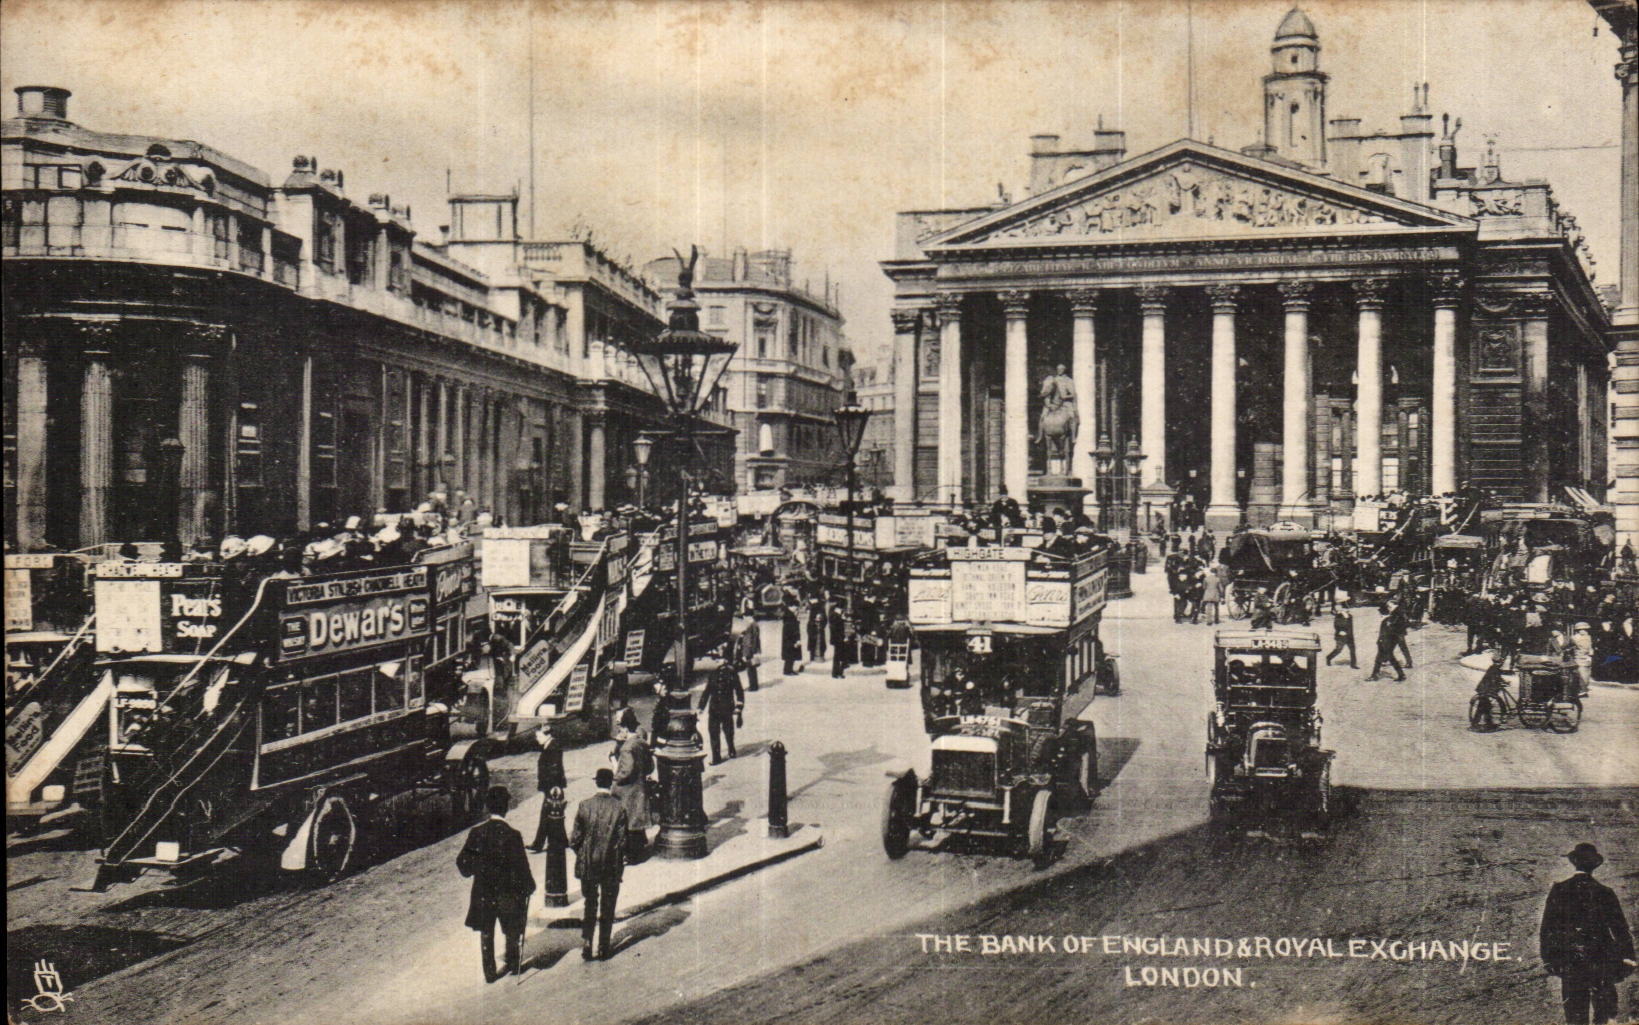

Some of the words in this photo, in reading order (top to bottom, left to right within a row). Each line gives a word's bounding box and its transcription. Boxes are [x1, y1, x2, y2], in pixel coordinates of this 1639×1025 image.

[953, 548, 1005, 559] HIGHGATE
[176, 620, 217, 638] Soap
[310, 601, 404, 647] Dewar's
[967, 635, 993, 653] 41
